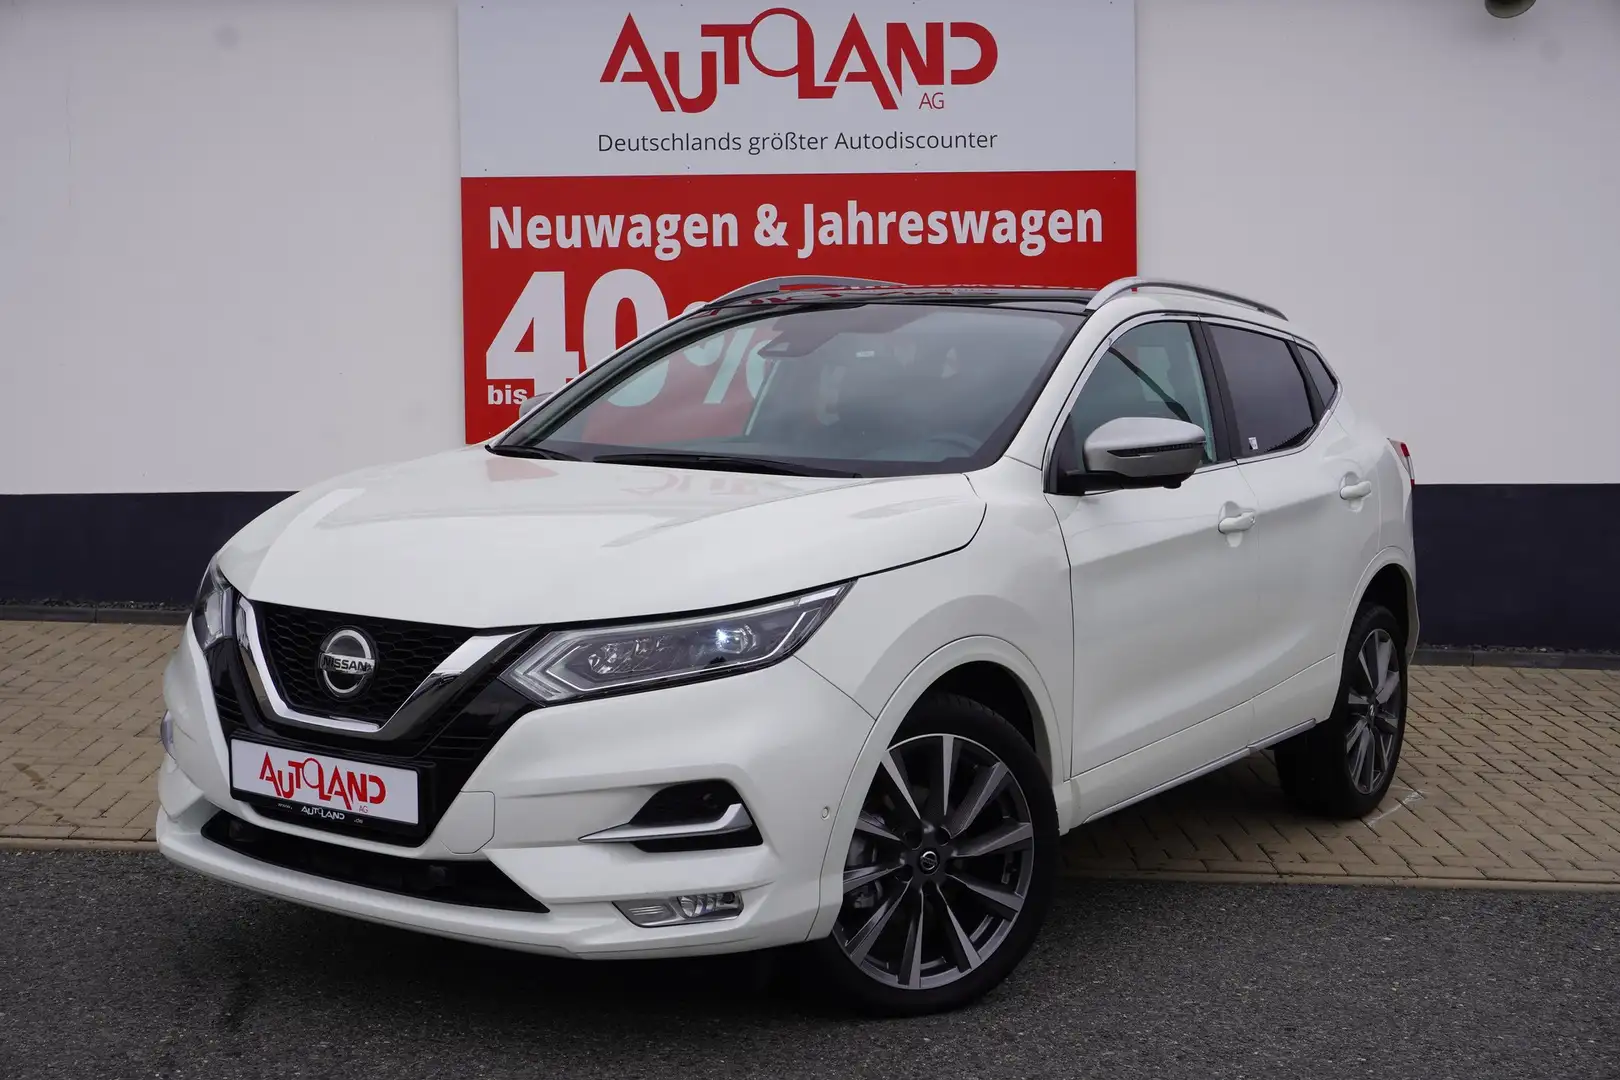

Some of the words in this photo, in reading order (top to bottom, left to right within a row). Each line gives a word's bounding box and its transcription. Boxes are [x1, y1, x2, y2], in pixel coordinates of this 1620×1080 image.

[600, 7, 998, 114] AUTOLAND
[919, 92, 945, 110] AG
[598, 133, 742, 153] Deutschlands
[748, 132, 828, 155] größter
[834, 131, 998, 150] Autodiscounter
[489, 205, 739, 261] Neuwagen
[754, 204, 789, 247] &
[797, 201, 1103, 258] Jahreswagen
[487, 385, 528, 405] bis
[323, 656, 368, 671] NISSAN
[259, 752, 387, 810] AUTOLAND
[301, 806, 345, 820] AUTOLAND
[359, 805, 369, 813] AG
